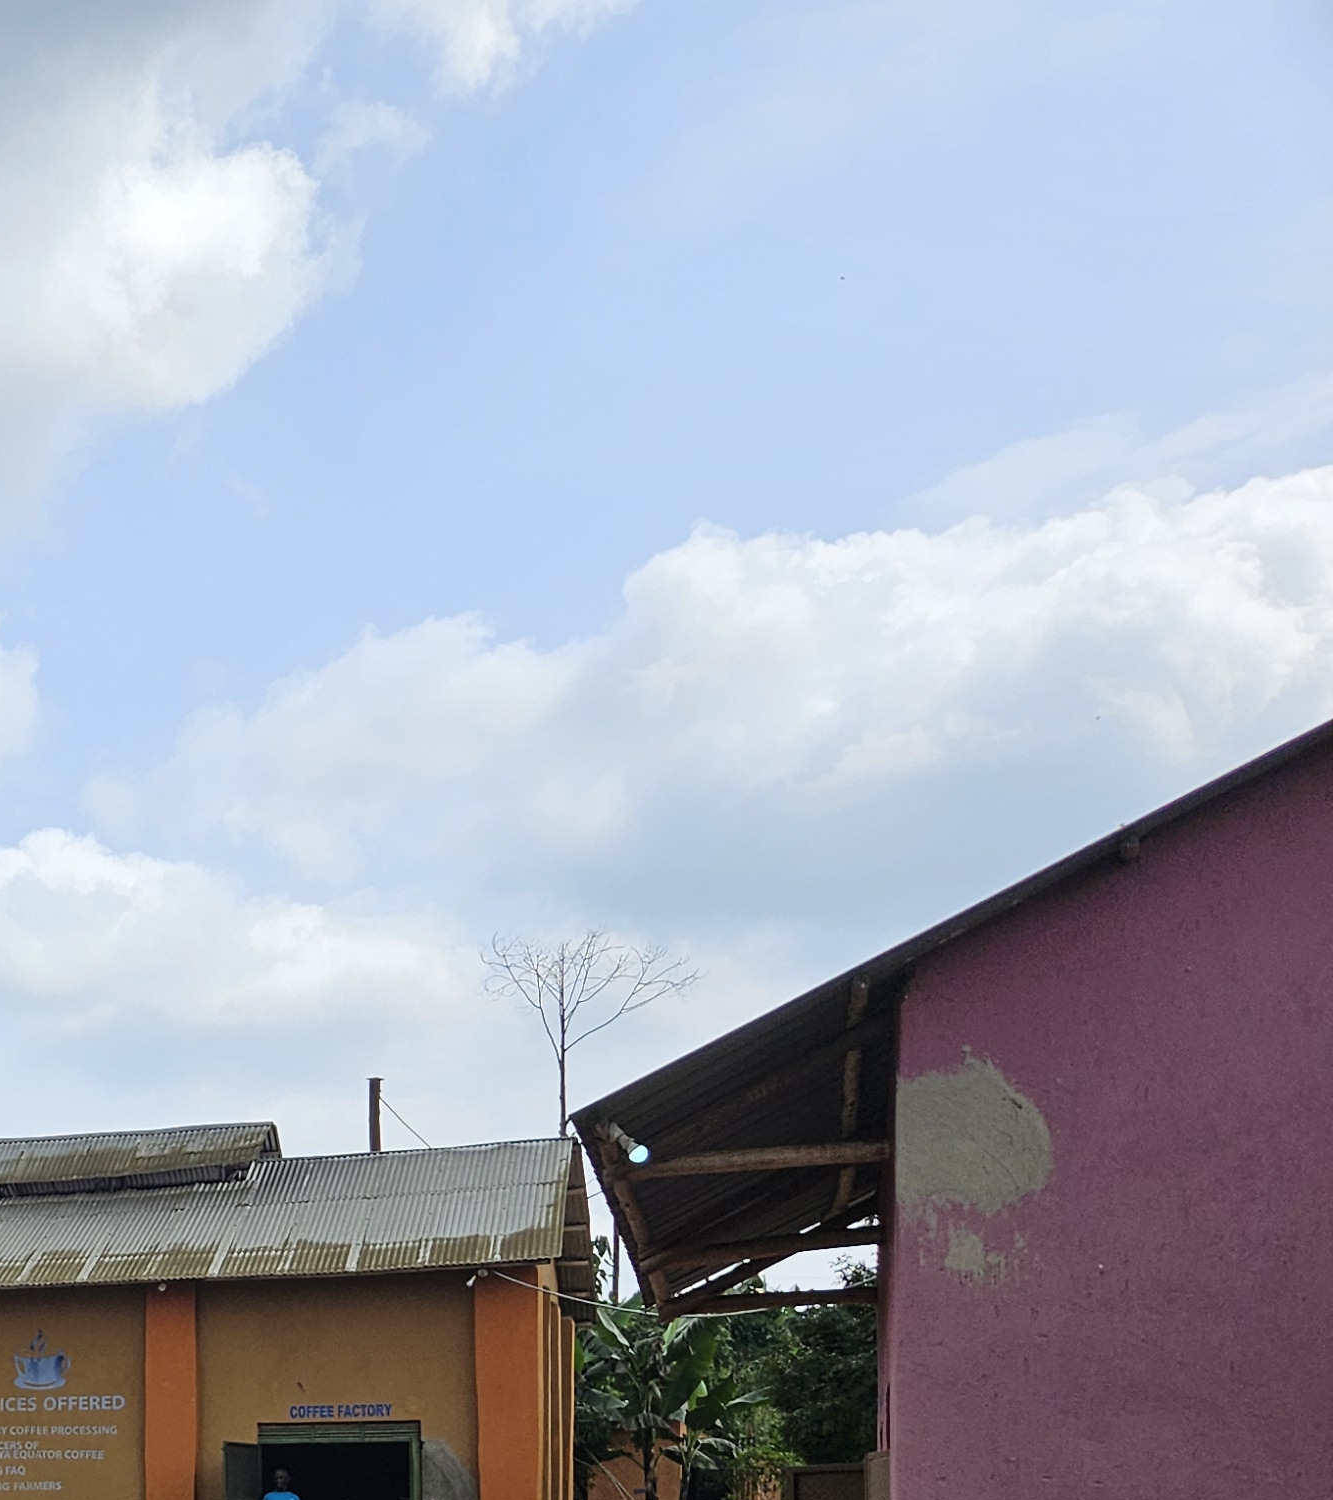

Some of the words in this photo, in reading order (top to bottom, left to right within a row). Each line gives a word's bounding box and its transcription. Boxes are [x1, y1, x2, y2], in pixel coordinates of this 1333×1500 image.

[43, 1395, 126, 1411] OFFERED
[289, 1405, 335, 1419] COFFEE
[337, 1403, 392, 1418] FACTORY
[9, 1425, 48, 1436] COFFEE
[50, 1425, 118, 1436] PROCESSING
[24, 1441, 39, 1450] OF
[13, 1450, 63, 1460] EQUATOR
[64, 1450, 104, 1460] COFFEE
[5, 1465, 26, 1476] FAQ
[13, 1481, 62, 1491] FARMERS
